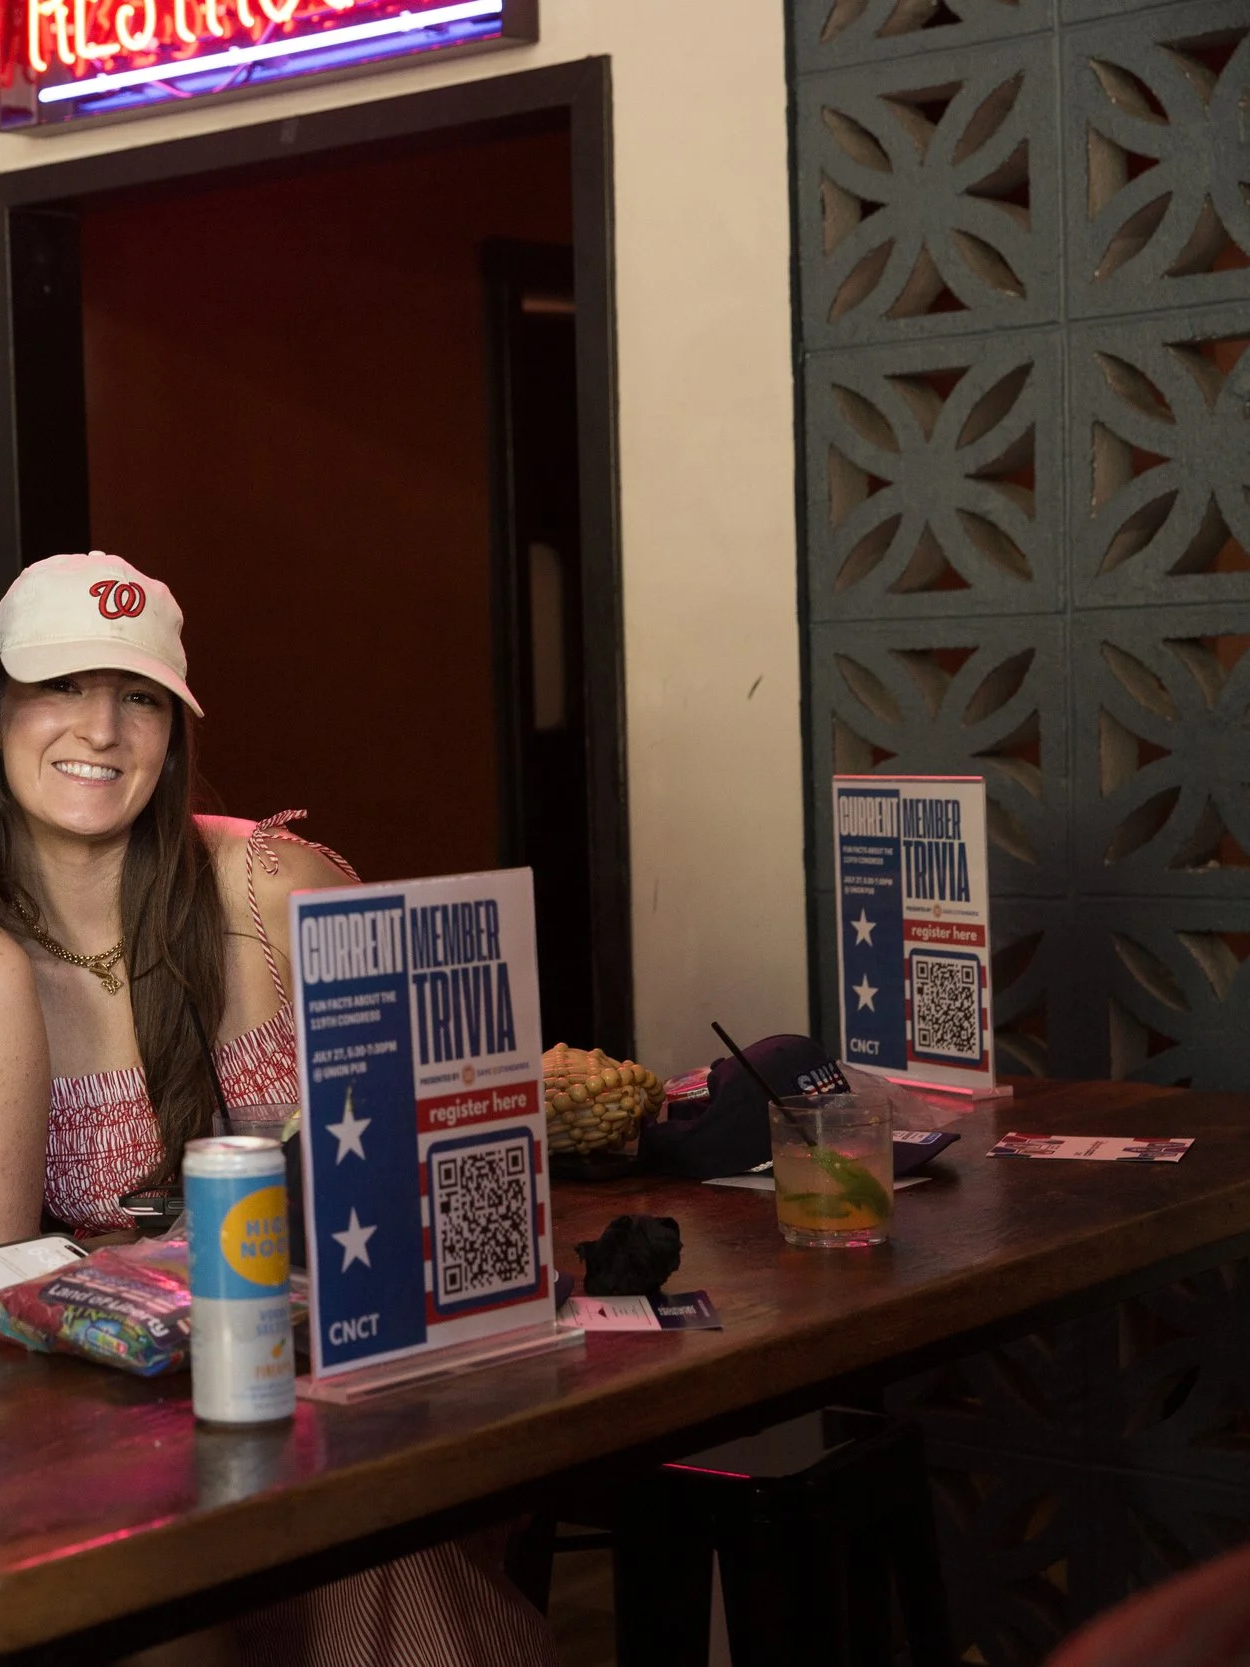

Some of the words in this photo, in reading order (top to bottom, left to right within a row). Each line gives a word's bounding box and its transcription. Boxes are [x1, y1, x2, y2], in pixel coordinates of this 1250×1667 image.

[89, 579, 146, 620] W
[839, 795, 899, 838] CURRENT
[902, 799, 962, 840] MEMBER
[903, 840, 971, 903] TRIVIA
[301, 908, 404, 985] CURRENT
[410, 899, 502, 971] MEMBER
[911, 924, 951, 941] register
[953, 925, 978, 941] here
[353, 992, 380, 1007] ABOUT
[381, 990, 397, 1004] THE
[412, 962, 517, 1066] TRIVIA
[850, 1037, 881, 1056] CNCT
[429, 1097, 490, 1126] register
[493, 1090, 527, 1112] here
[329, 1312, 380, 1346] CNCT
